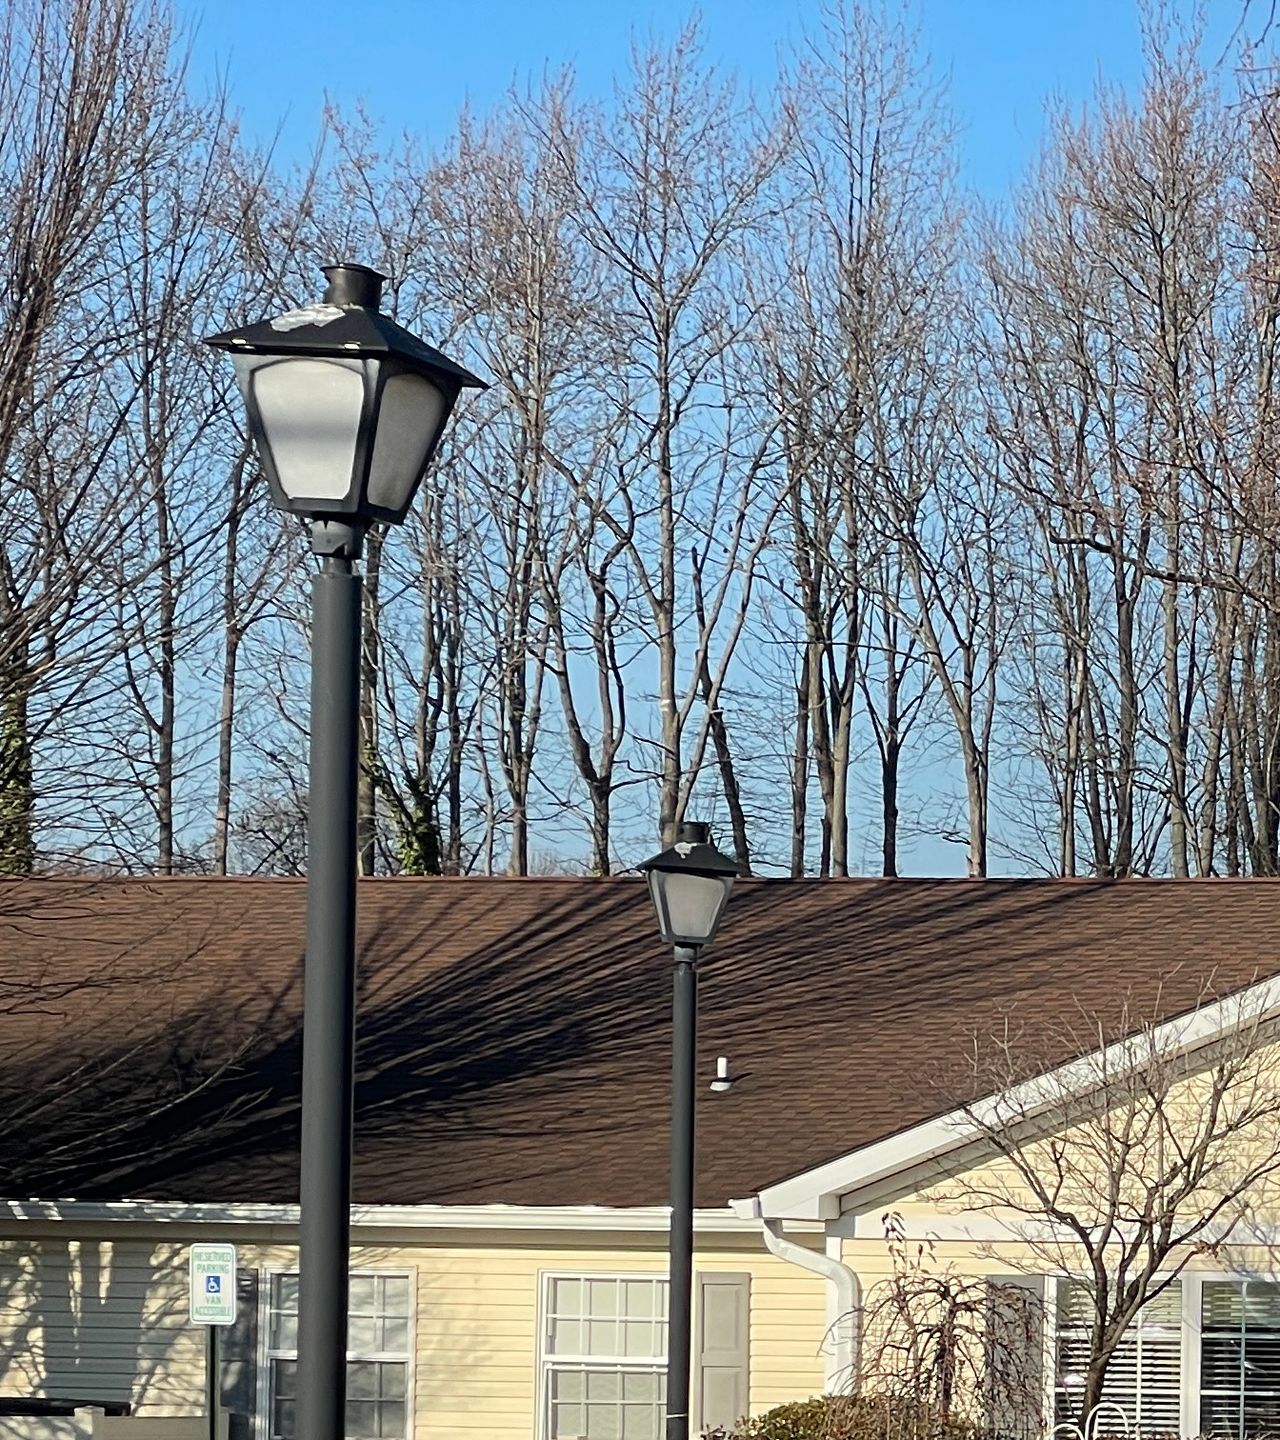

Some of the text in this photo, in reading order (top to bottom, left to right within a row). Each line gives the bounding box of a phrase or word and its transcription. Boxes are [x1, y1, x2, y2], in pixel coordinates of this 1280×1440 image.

[194, 1252, 231, 1262] RESERVED
[197, 1264, 230, 1274] PARKING
[206, 1296, 221, 1305] VAN
[195, 1306, 232, 1316] ACCESSIBLE
